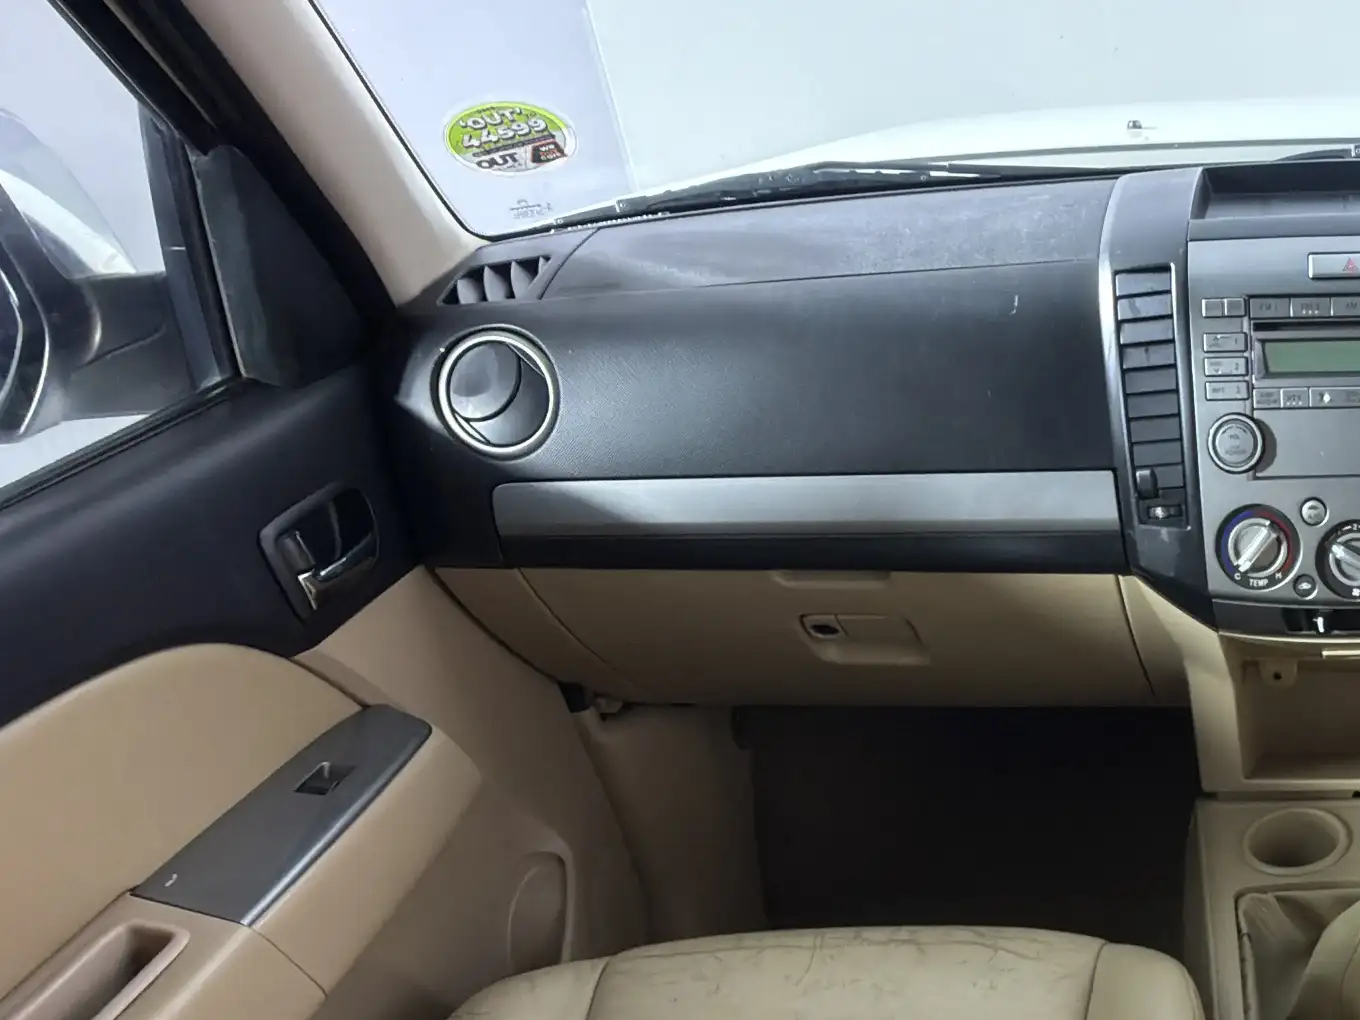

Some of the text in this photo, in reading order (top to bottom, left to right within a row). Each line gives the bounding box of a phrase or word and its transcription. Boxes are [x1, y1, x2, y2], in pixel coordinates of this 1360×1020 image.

[462, 117, 547, 148] 44599
[476, 152, 518, 169] OUT
[1352, 523, 1358, 531] 2
[1234, 572, 1242, 580] C
[1249, 578, 1269, 587] TEMP
